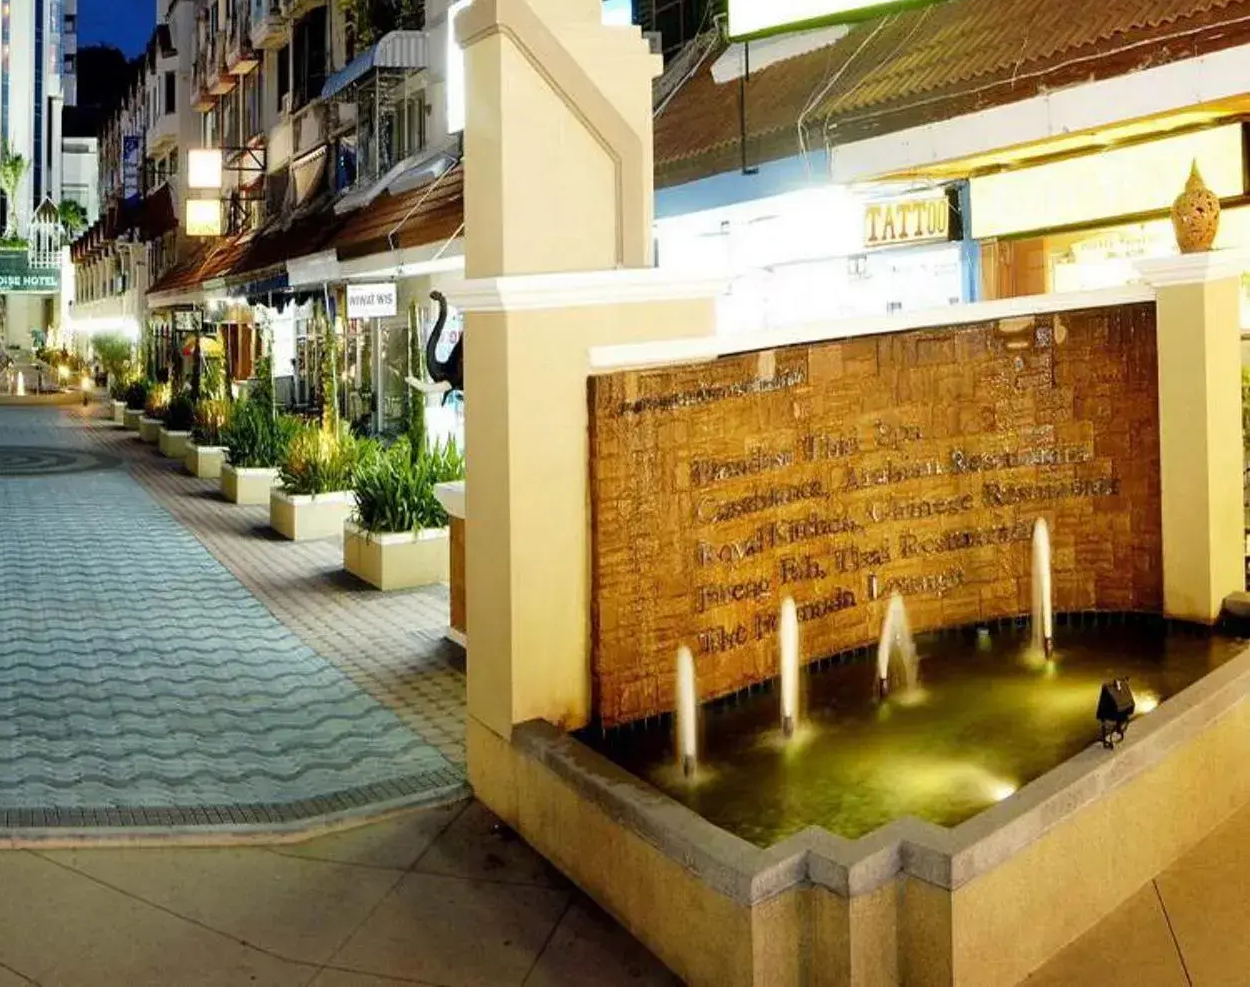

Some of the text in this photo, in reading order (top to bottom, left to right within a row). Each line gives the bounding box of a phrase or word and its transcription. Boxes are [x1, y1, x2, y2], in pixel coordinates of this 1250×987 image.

[866, 200, 946, 241] TATTOO
[23, 275, 58, 286] HOTEL
[698, 623, 748, 654] The
